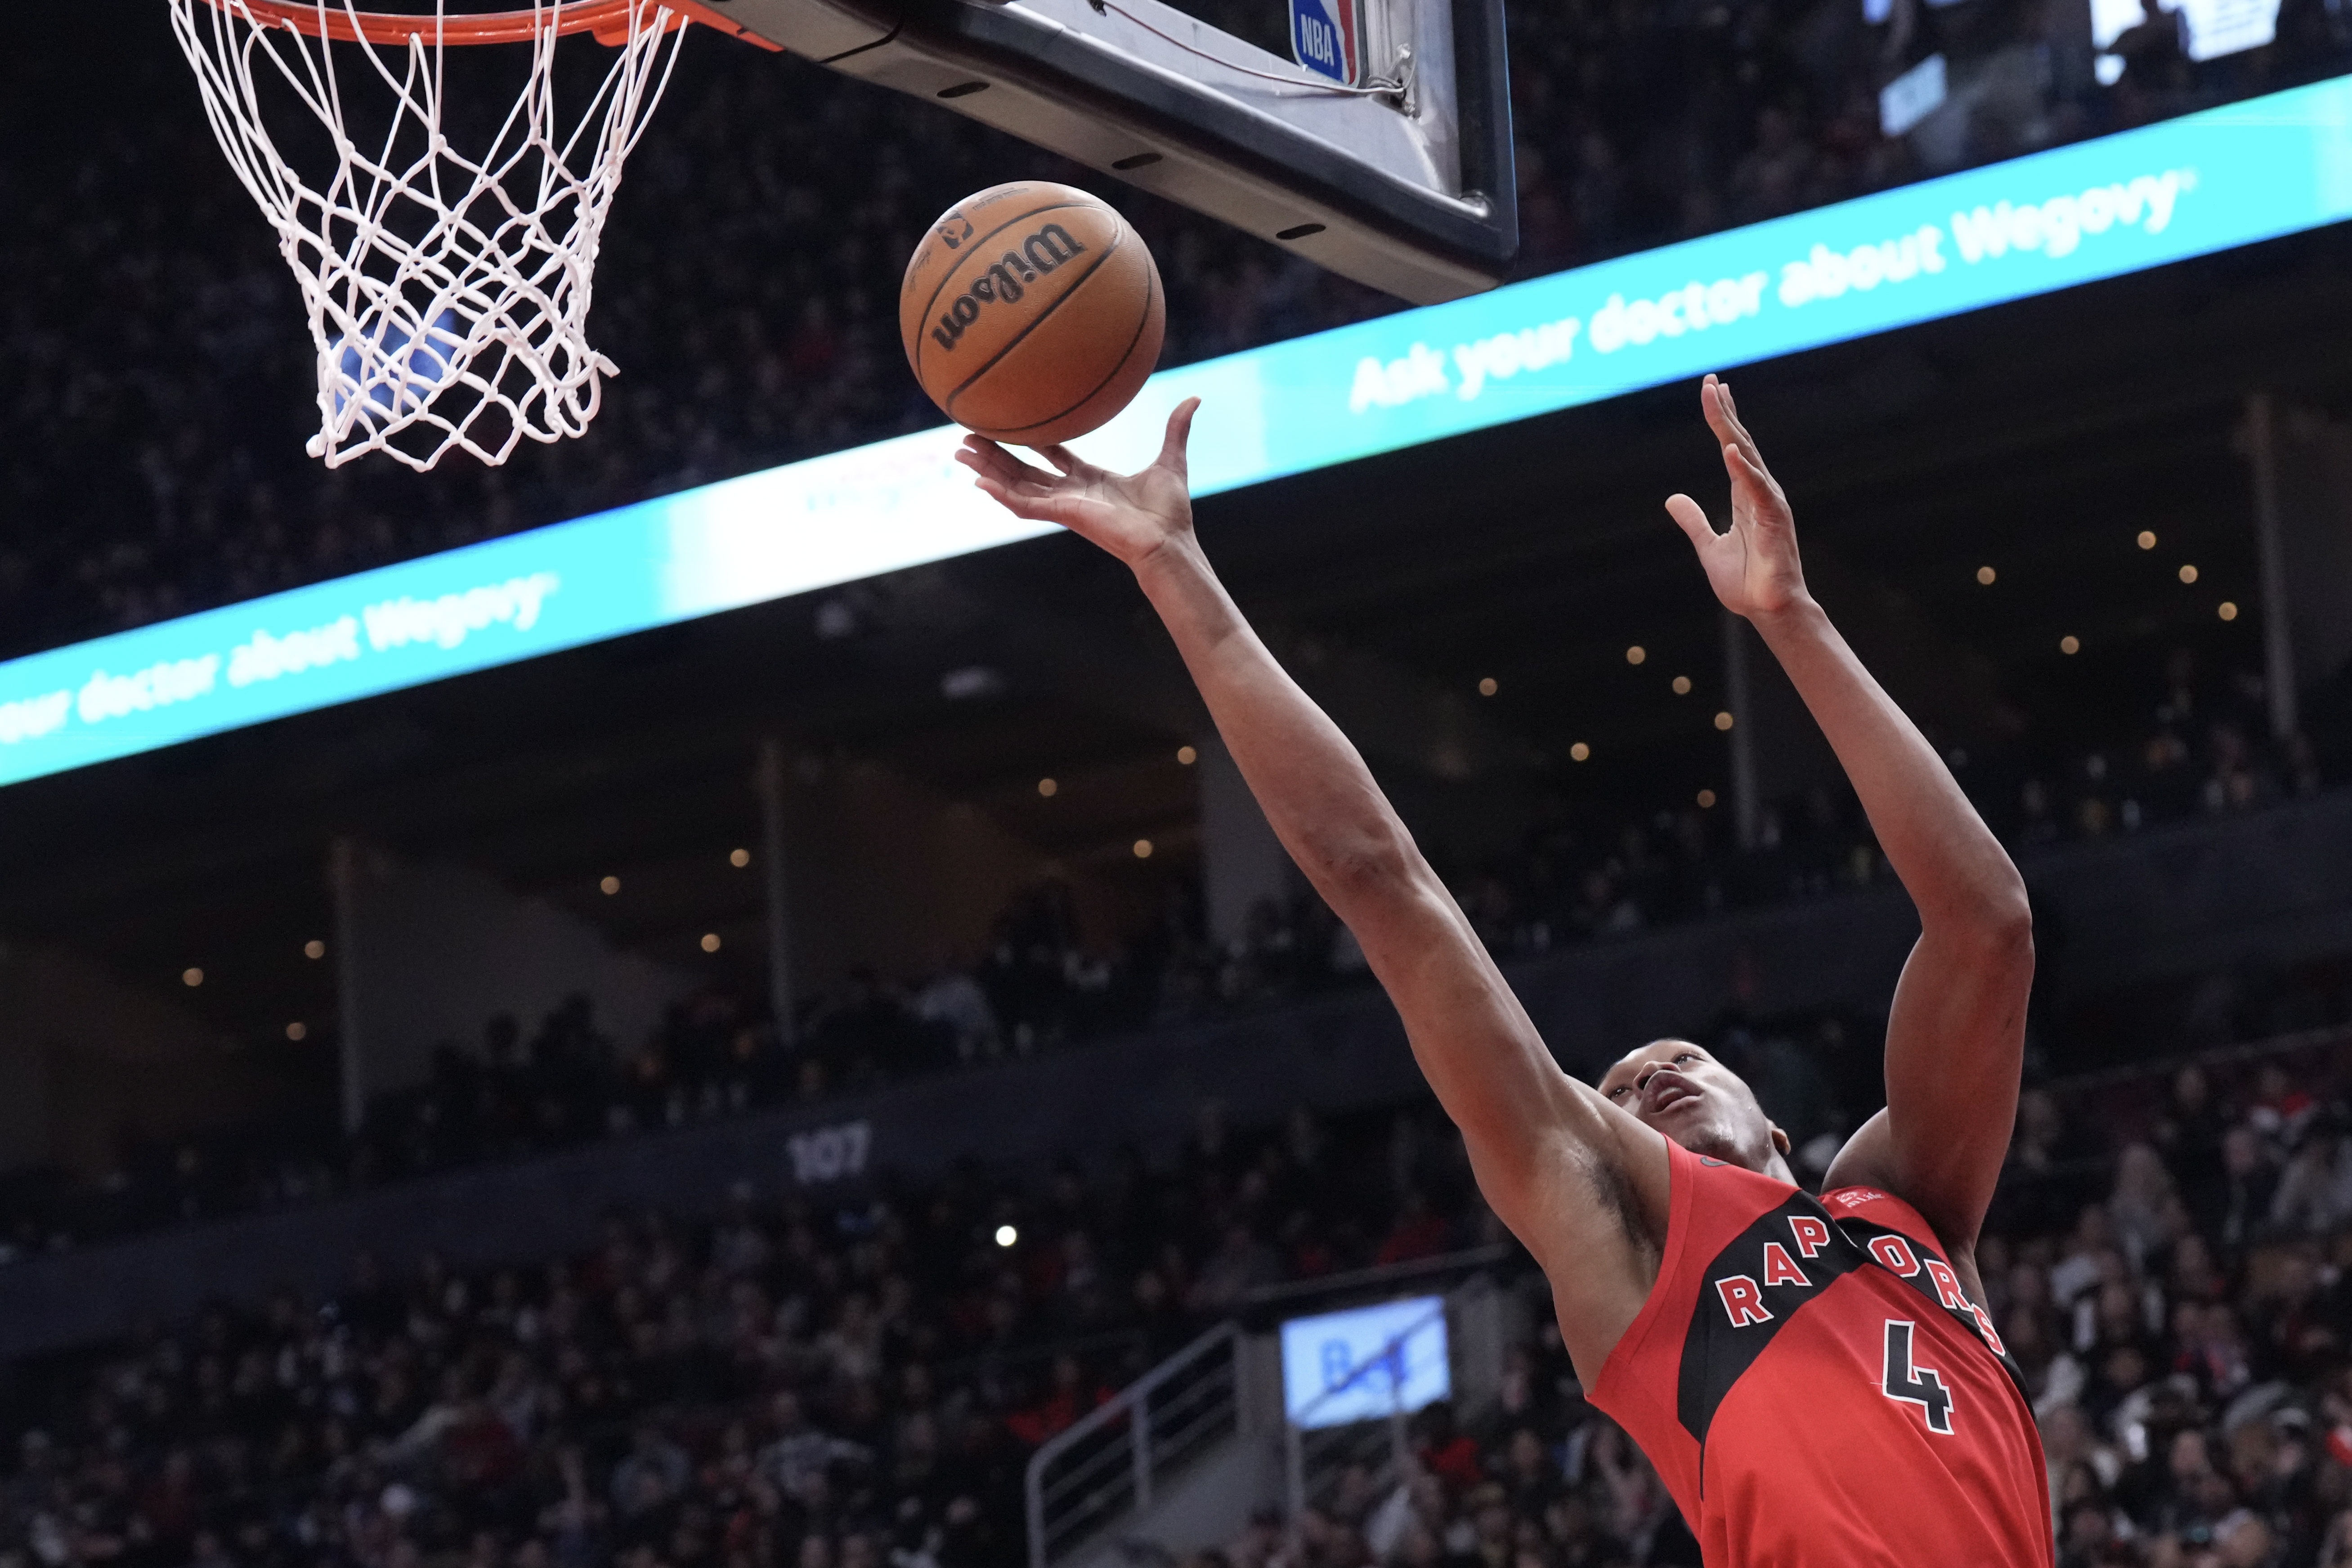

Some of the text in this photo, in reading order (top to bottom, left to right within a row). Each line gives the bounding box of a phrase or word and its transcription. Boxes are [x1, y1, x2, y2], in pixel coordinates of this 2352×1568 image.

[1301, 13, 1335, 66] NBA
[930, 223, 1087, 352] Wilson
[1351, 342, 1447, 413] Ask
[1455, 317, 1579, 400] your
[1590, 271, 1768, 353] doctor
[1779, 224, 1945, 307] about
[78, 654, 220, 724] doctor
[227, 614, 360, 687] about
[788, 1120, 872, 1183] 107
[1715, 1216, 2006, 1356] RAPORS
[1883, 1318, 1954, 1435] 4
